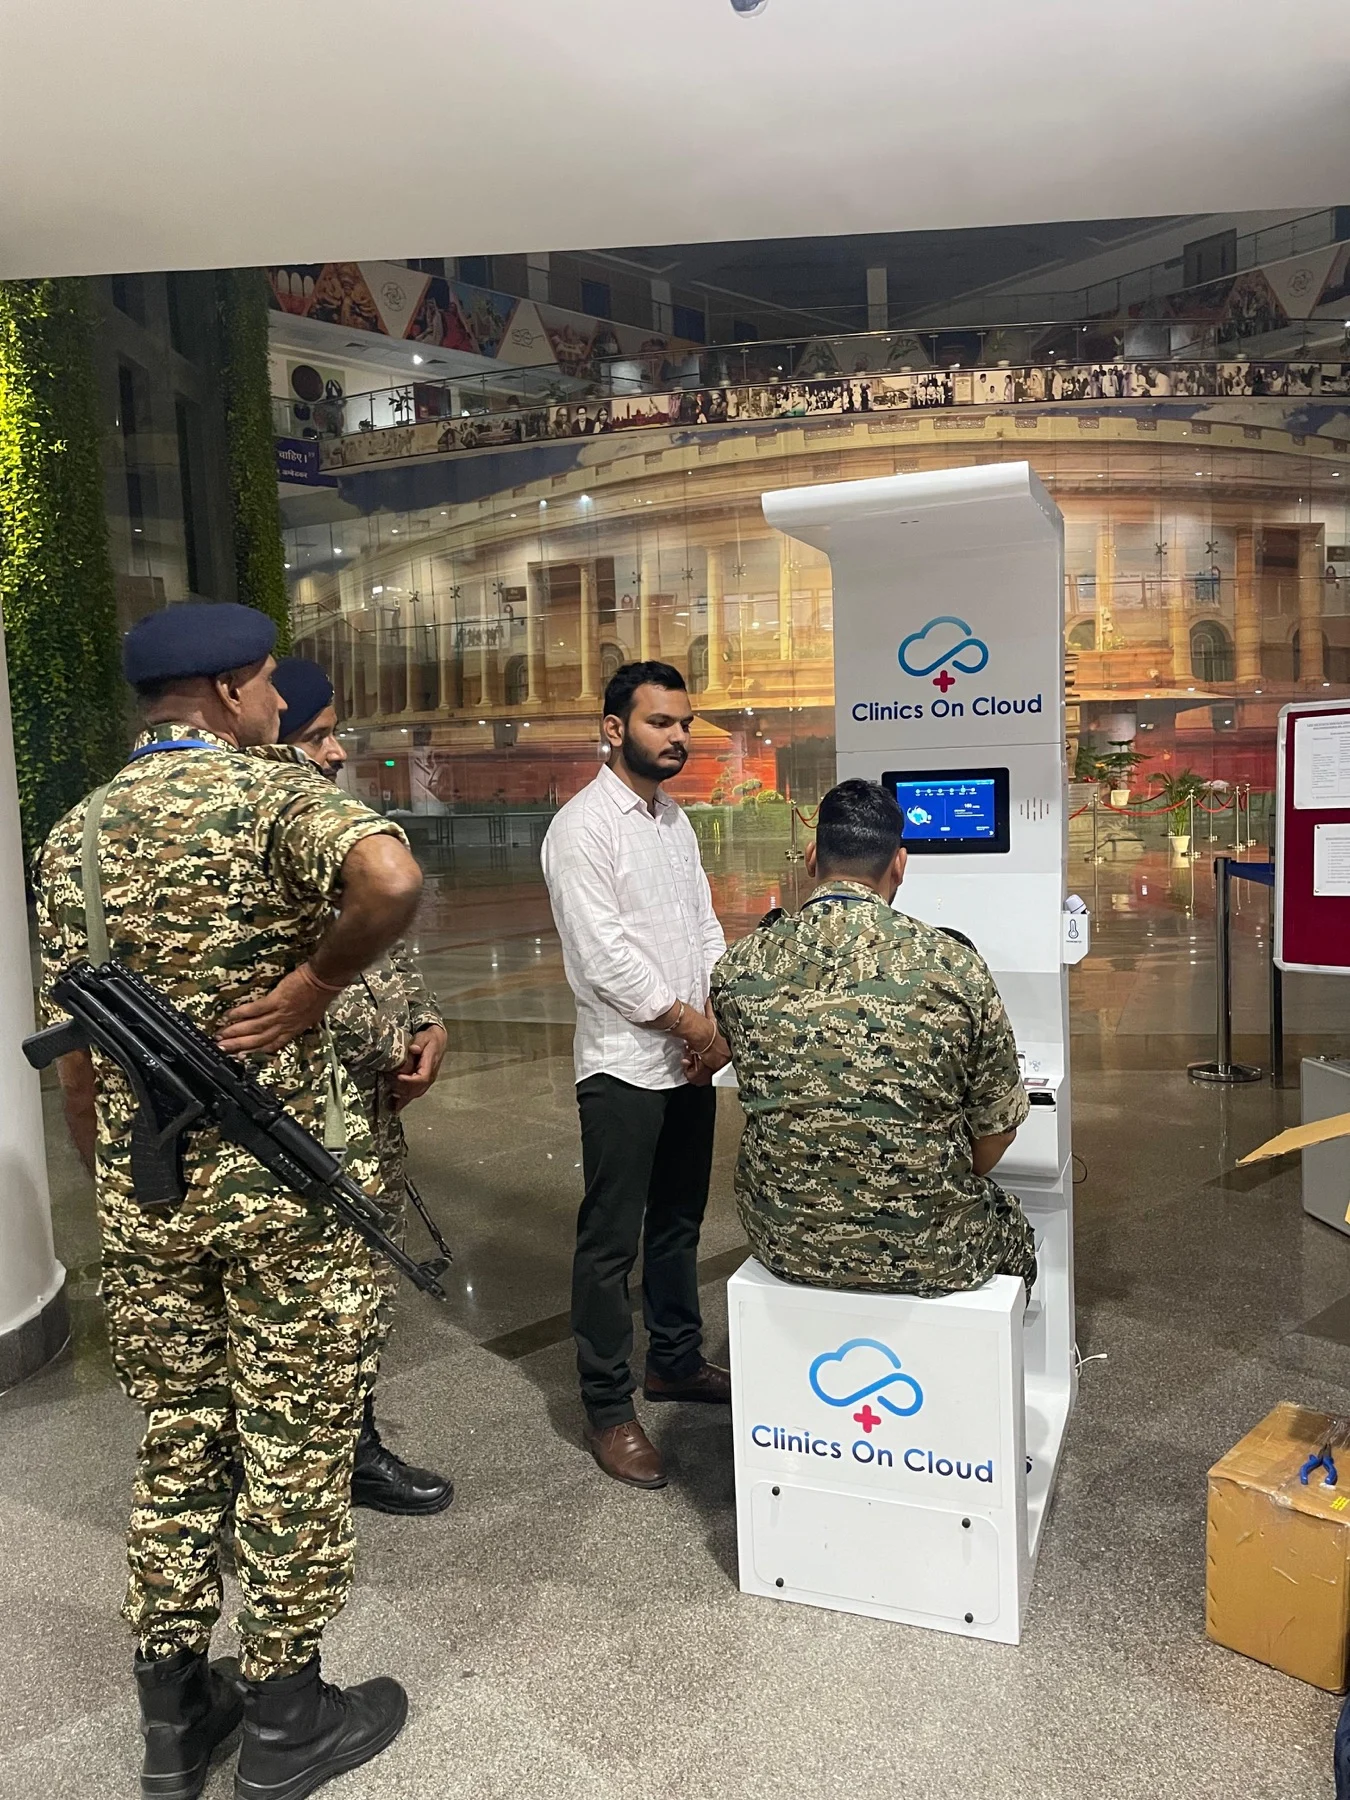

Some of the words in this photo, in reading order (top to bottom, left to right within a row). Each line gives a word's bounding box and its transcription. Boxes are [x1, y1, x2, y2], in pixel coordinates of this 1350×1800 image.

[852, 701, 923, 721] Clinics
[931, 699, 964, 718] On
[972, 694, 1042, 716] Cloud
[751, 1424, 842, 1459] Clinics
[851, 1440, 893, 1468] On
[903, 1448, 993, 1483] Cloud
